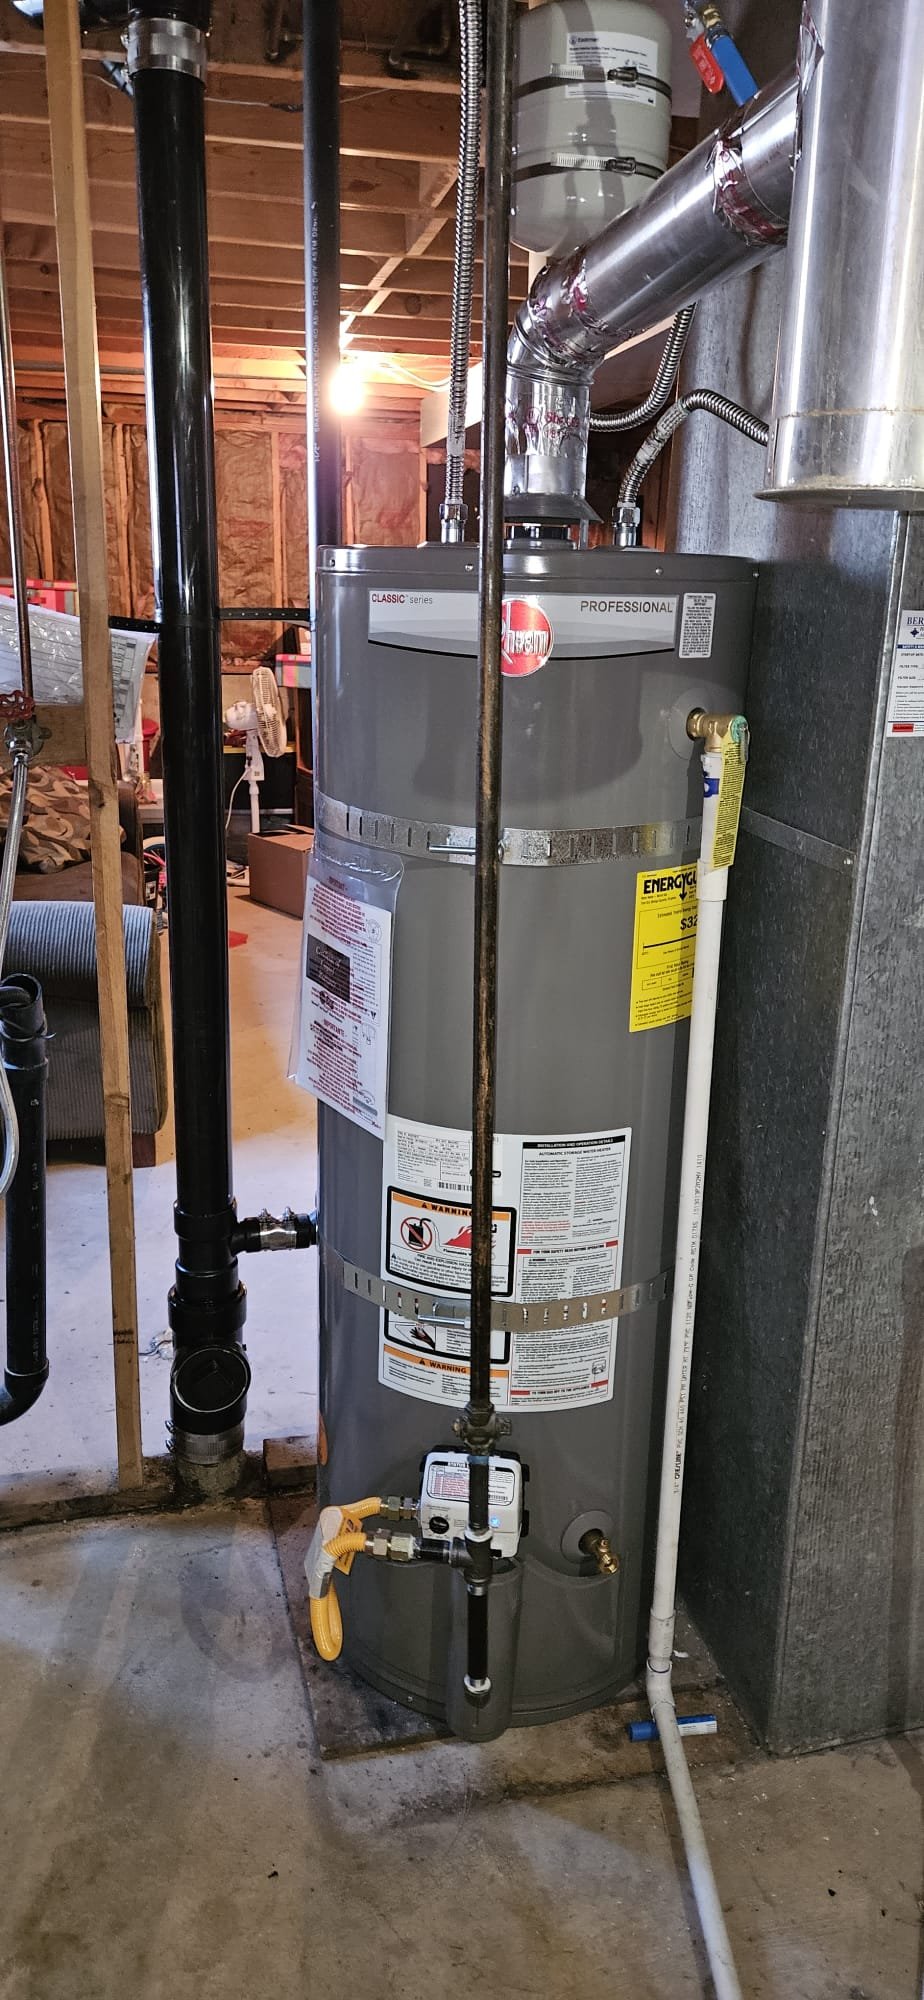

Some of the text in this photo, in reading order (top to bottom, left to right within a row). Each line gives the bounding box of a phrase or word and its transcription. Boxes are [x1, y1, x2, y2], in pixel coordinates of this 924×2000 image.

[372, 593, 433, 604] CLASSIC series
[580, 600, 673, 613] PROFESSIONAL
[429, 1360, 467, 1373] WARNING
